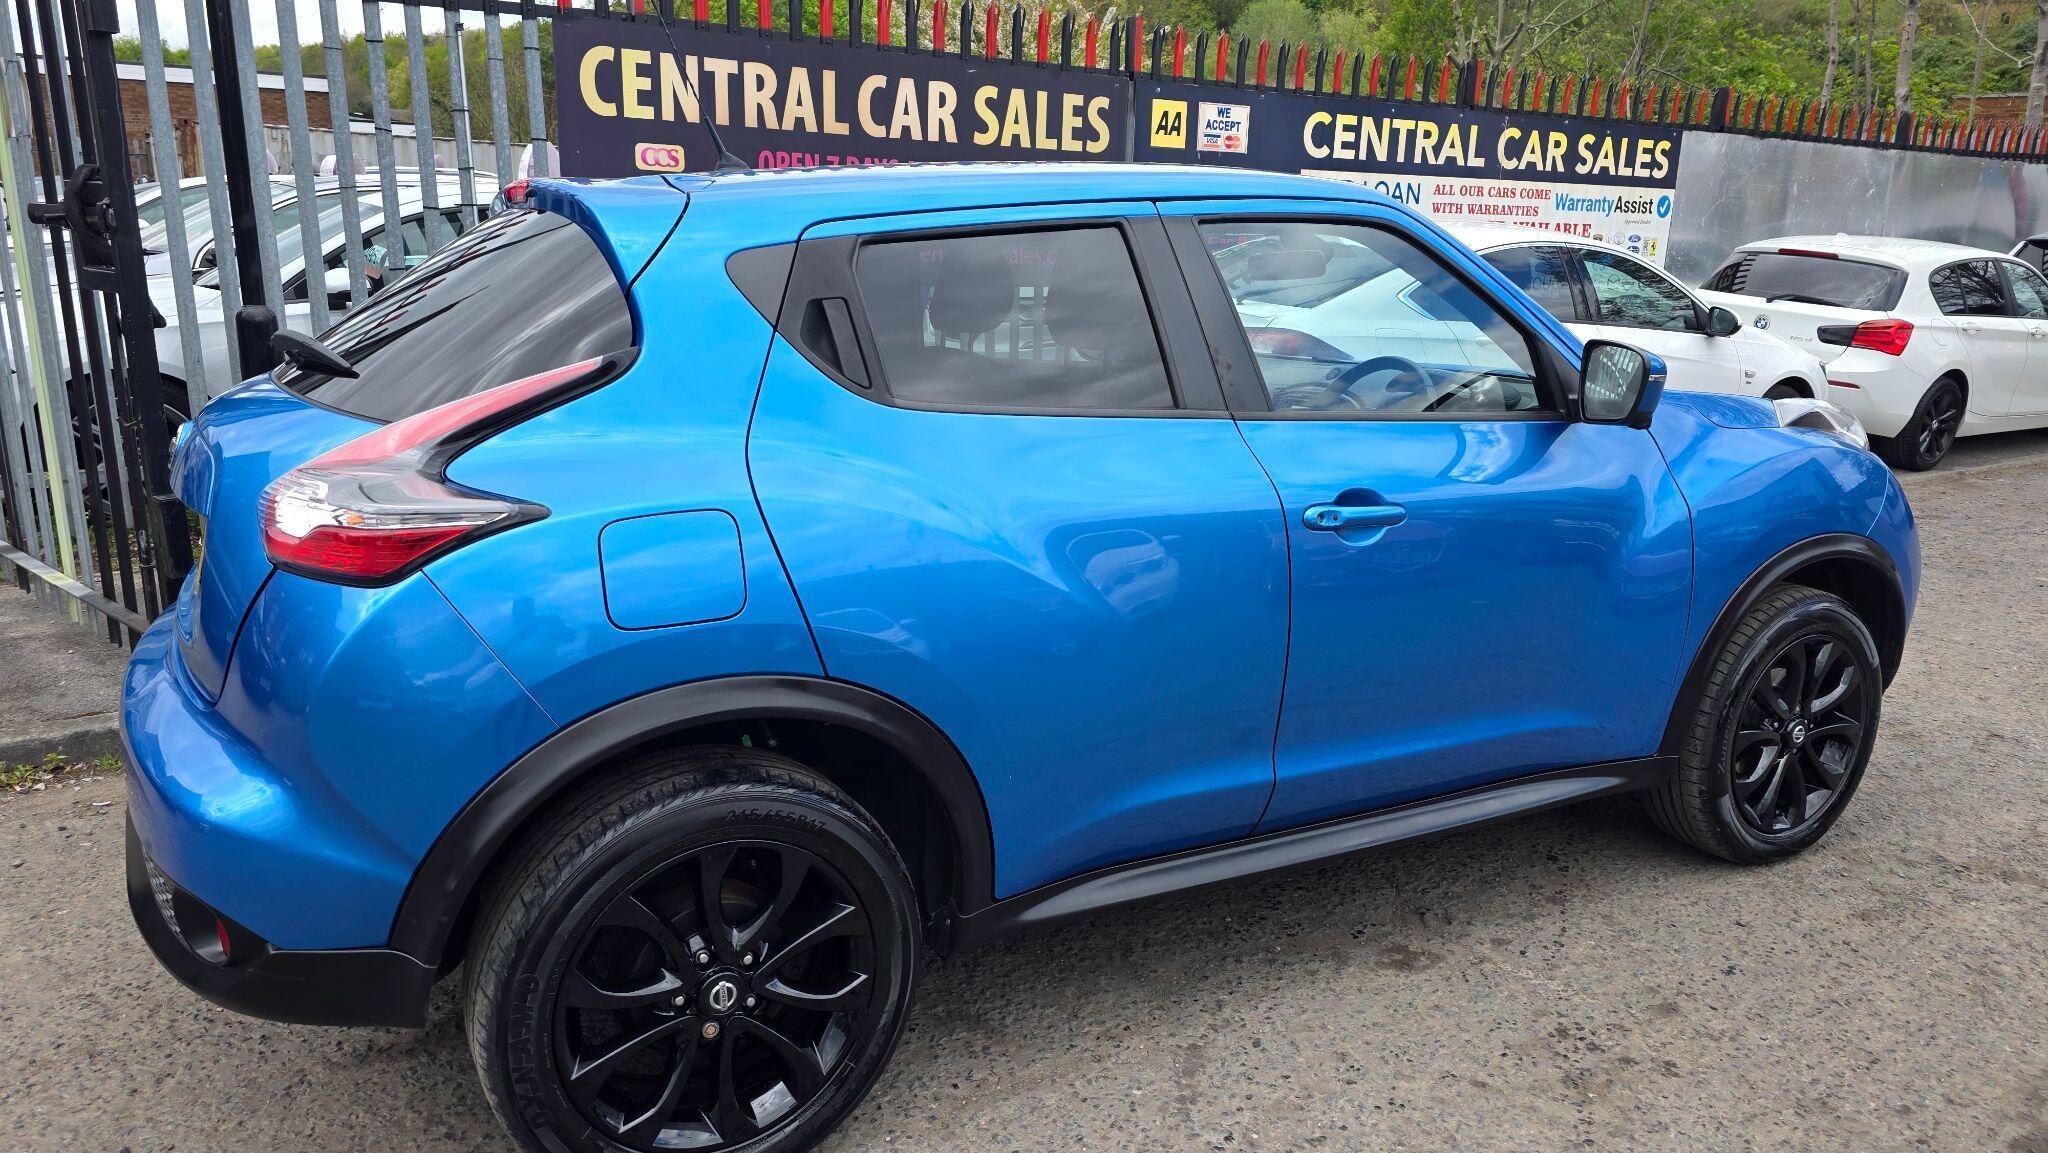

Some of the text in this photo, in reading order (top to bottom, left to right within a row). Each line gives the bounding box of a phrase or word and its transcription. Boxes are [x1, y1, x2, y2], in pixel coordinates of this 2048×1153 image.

[579, 45, 1110, 154] CENTRAL CAR SALES
[1217, 107, 1232, 118] WE
[1155, 111, 1181, 136] AA
[1205, 119, 1242, 132] ACCEPT
[1303, 111, 1672, 179] CENTRAL CAR SALES
[641, 147, 679, 167] CCS
[1433, 184, 1551, 200] ALL OUR CARS COME
[1432, 202, 1539, 217] WITH WARRANTIES
